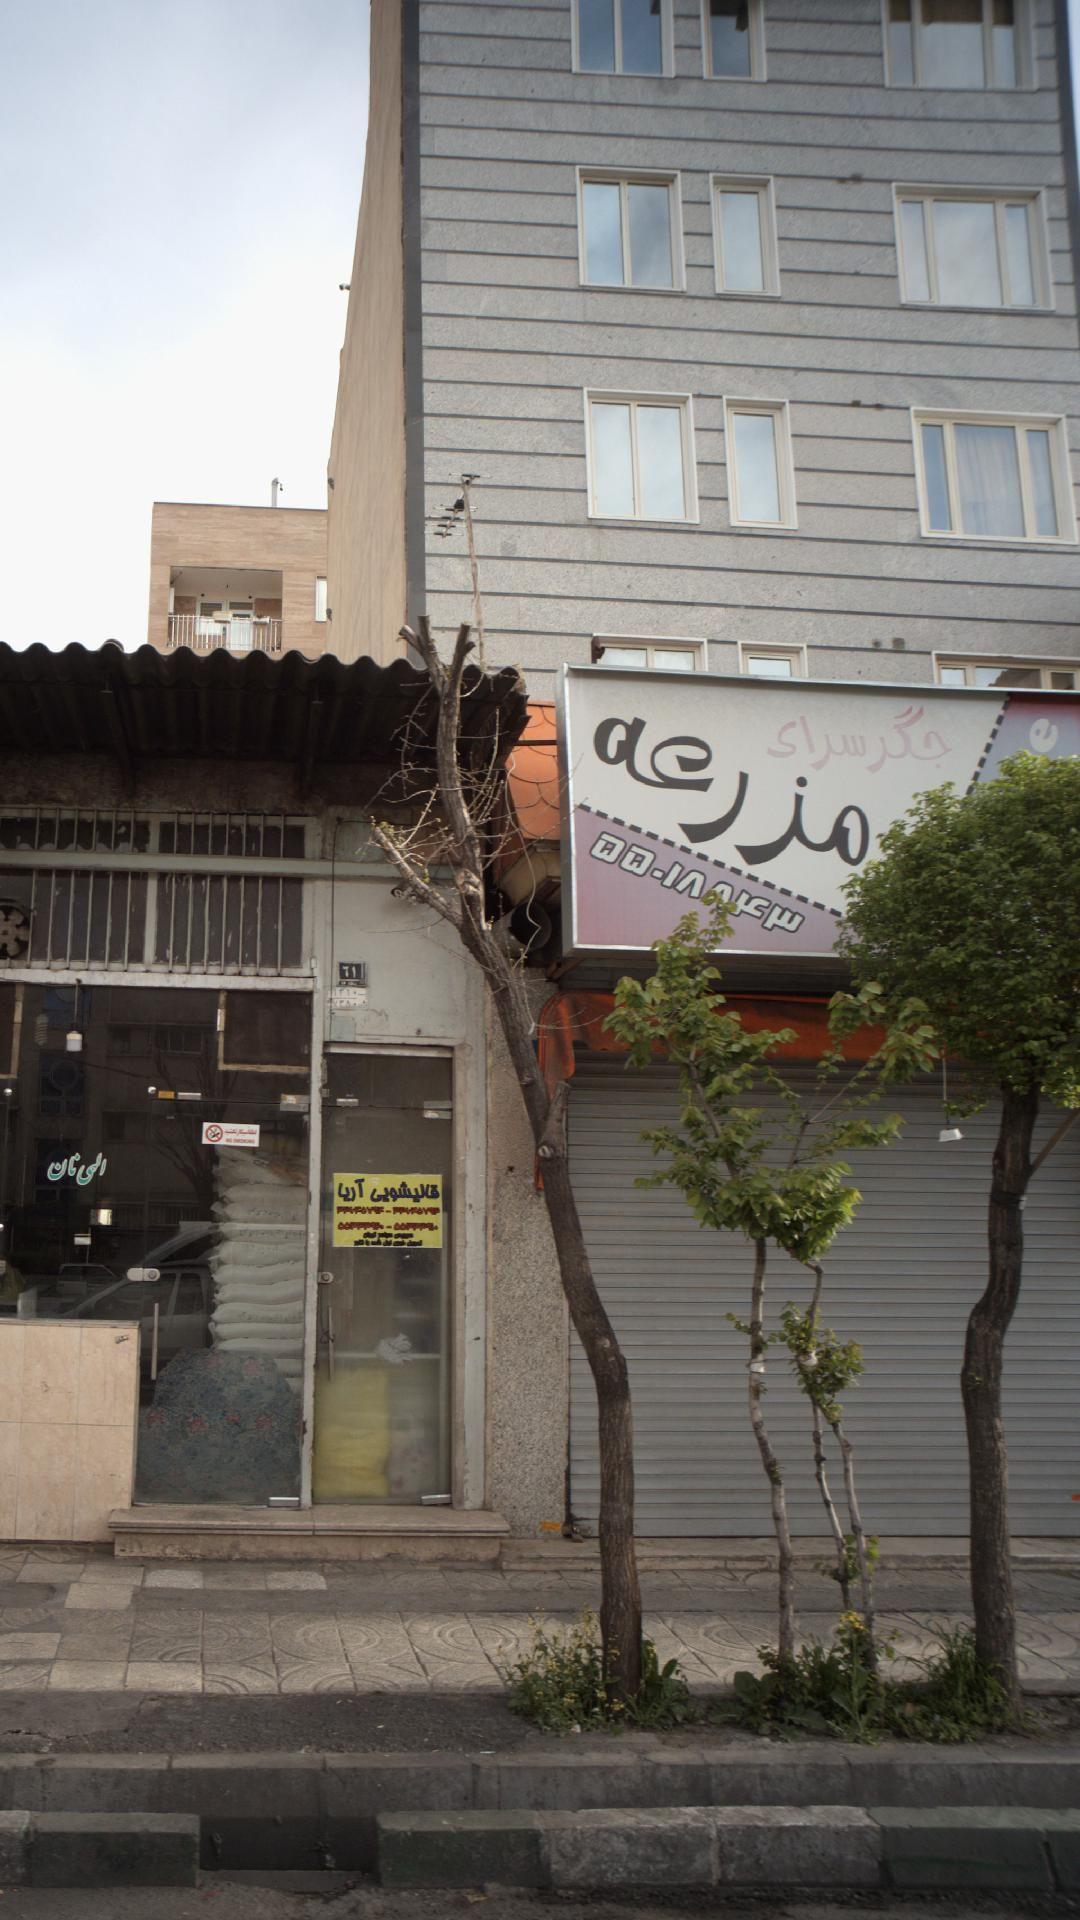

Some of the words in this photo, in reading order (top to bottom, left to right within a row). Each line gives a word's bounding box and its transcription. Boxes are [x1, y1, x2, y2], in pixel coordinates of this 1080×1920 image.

[593, 716, 869, 866] مزرعه
[337, 1178, 365, 1202] آریا
[370, 1181, 440, 1202] قالیشویی
